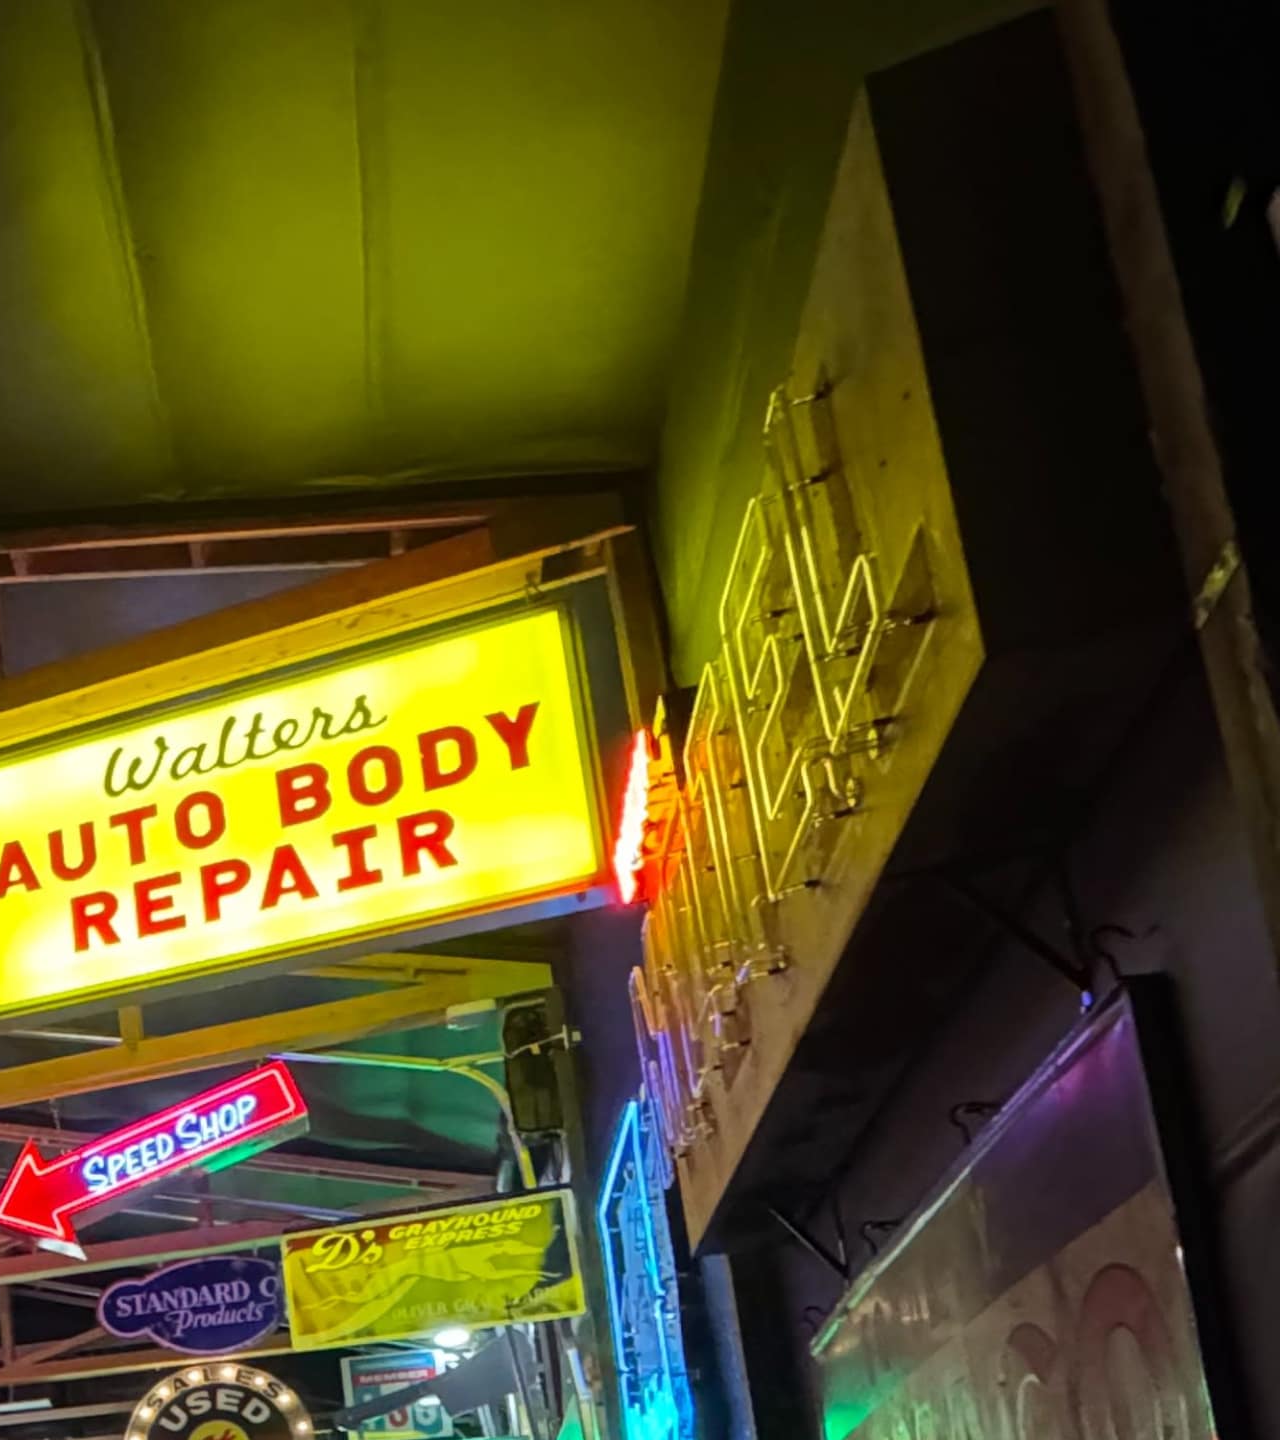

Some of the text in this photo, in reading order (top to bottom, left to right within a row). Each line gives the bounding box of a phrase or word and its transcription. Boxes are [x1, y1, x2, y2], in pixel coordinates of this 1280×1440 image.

[104, 694, 388, 799] Walters
[276, 702, 540, 827] BODY
[72, 809, 458, 952] REPAIR
[83, 1095, 257, 1193] SPEED SHOP
[306, 1204, 542, 1273] D's GRAYHOUND
[403, 1221, 524, 1251] EXPRESS
[115, 1279, 252, 1318] STANDARD
[164, 1300, 264, 1339] Products
[146, 1367, 286, 1409] SALES
[158, 1387, 272, 1432] USED
